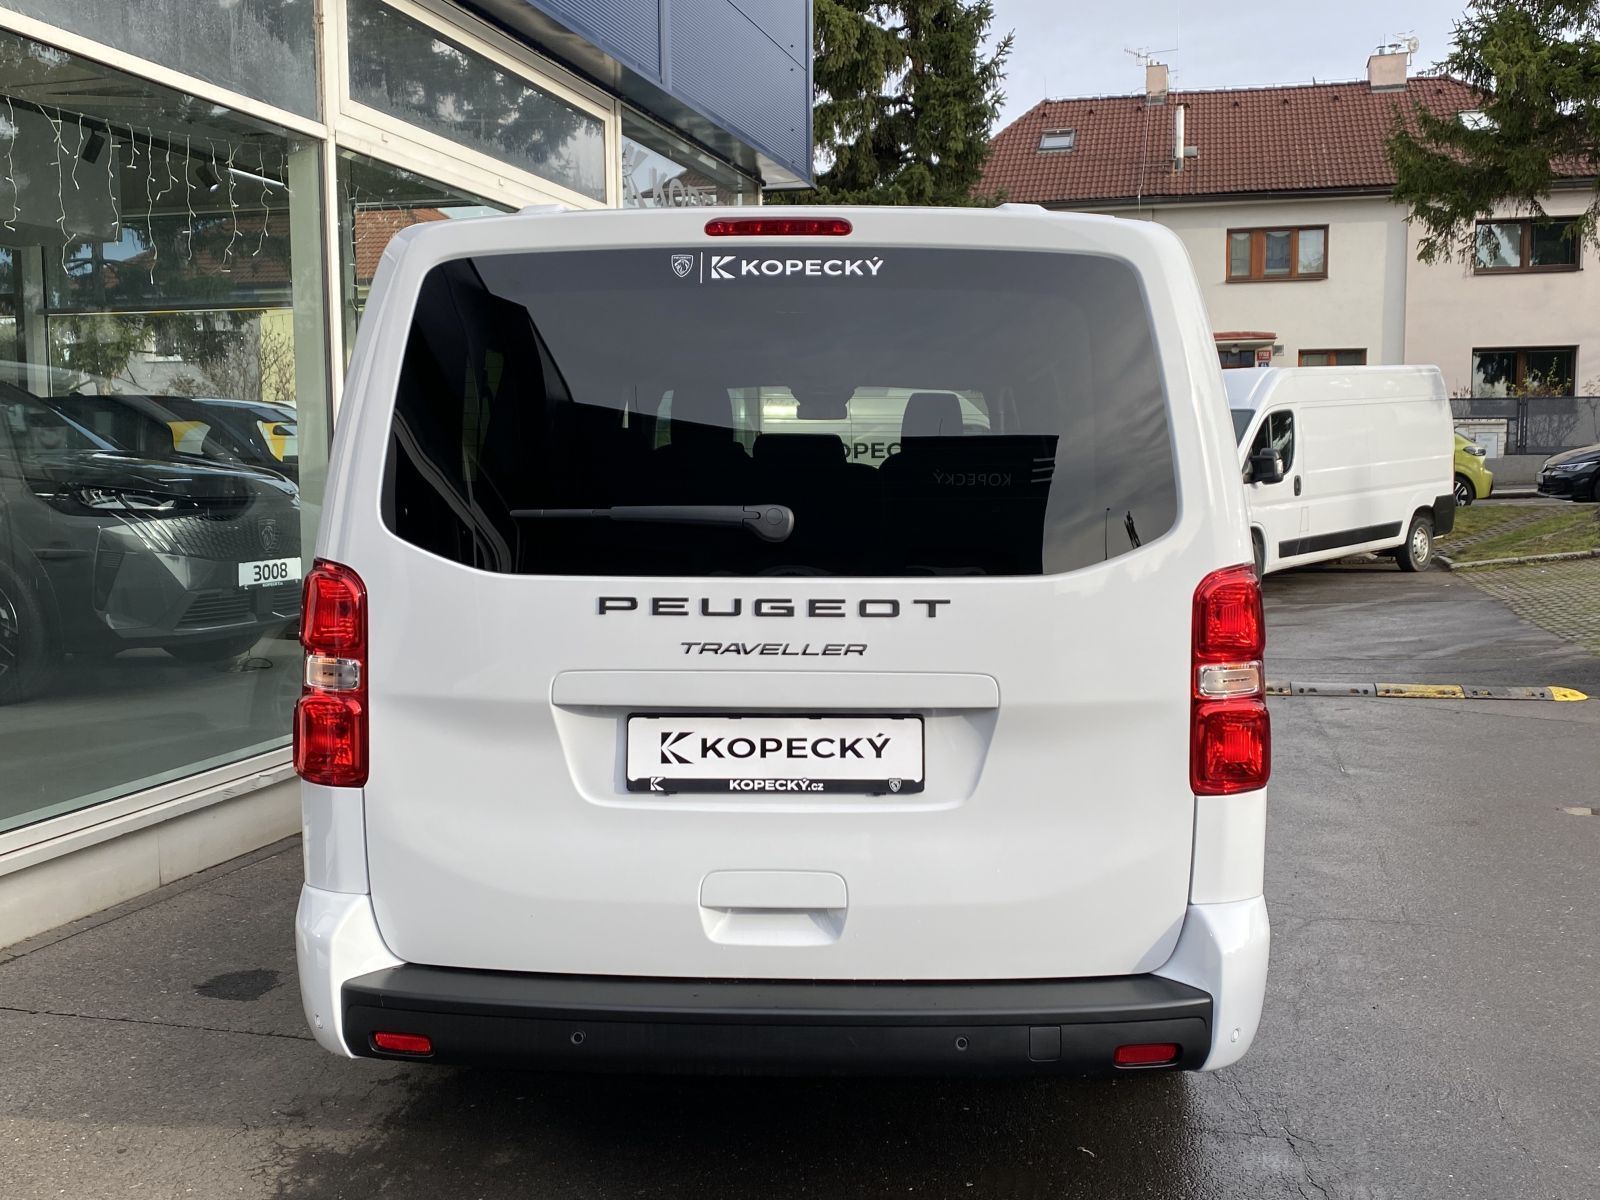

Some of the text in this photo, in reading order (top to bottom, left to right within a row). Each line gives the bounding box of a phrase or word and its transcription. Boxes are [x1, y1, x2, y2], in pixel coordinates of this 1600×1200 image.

[741, 256, 884, 276] KOPECKÝ
[253, 562, 288, 582] 3008
[598, 596, 951, 618] PEUGEOT
[680, 642, 868, 656] TRAVELLER
[701, 732, 891, 759] KOPECKÝ
[729, 777, 824, 791] KOPECKÝ.cz
